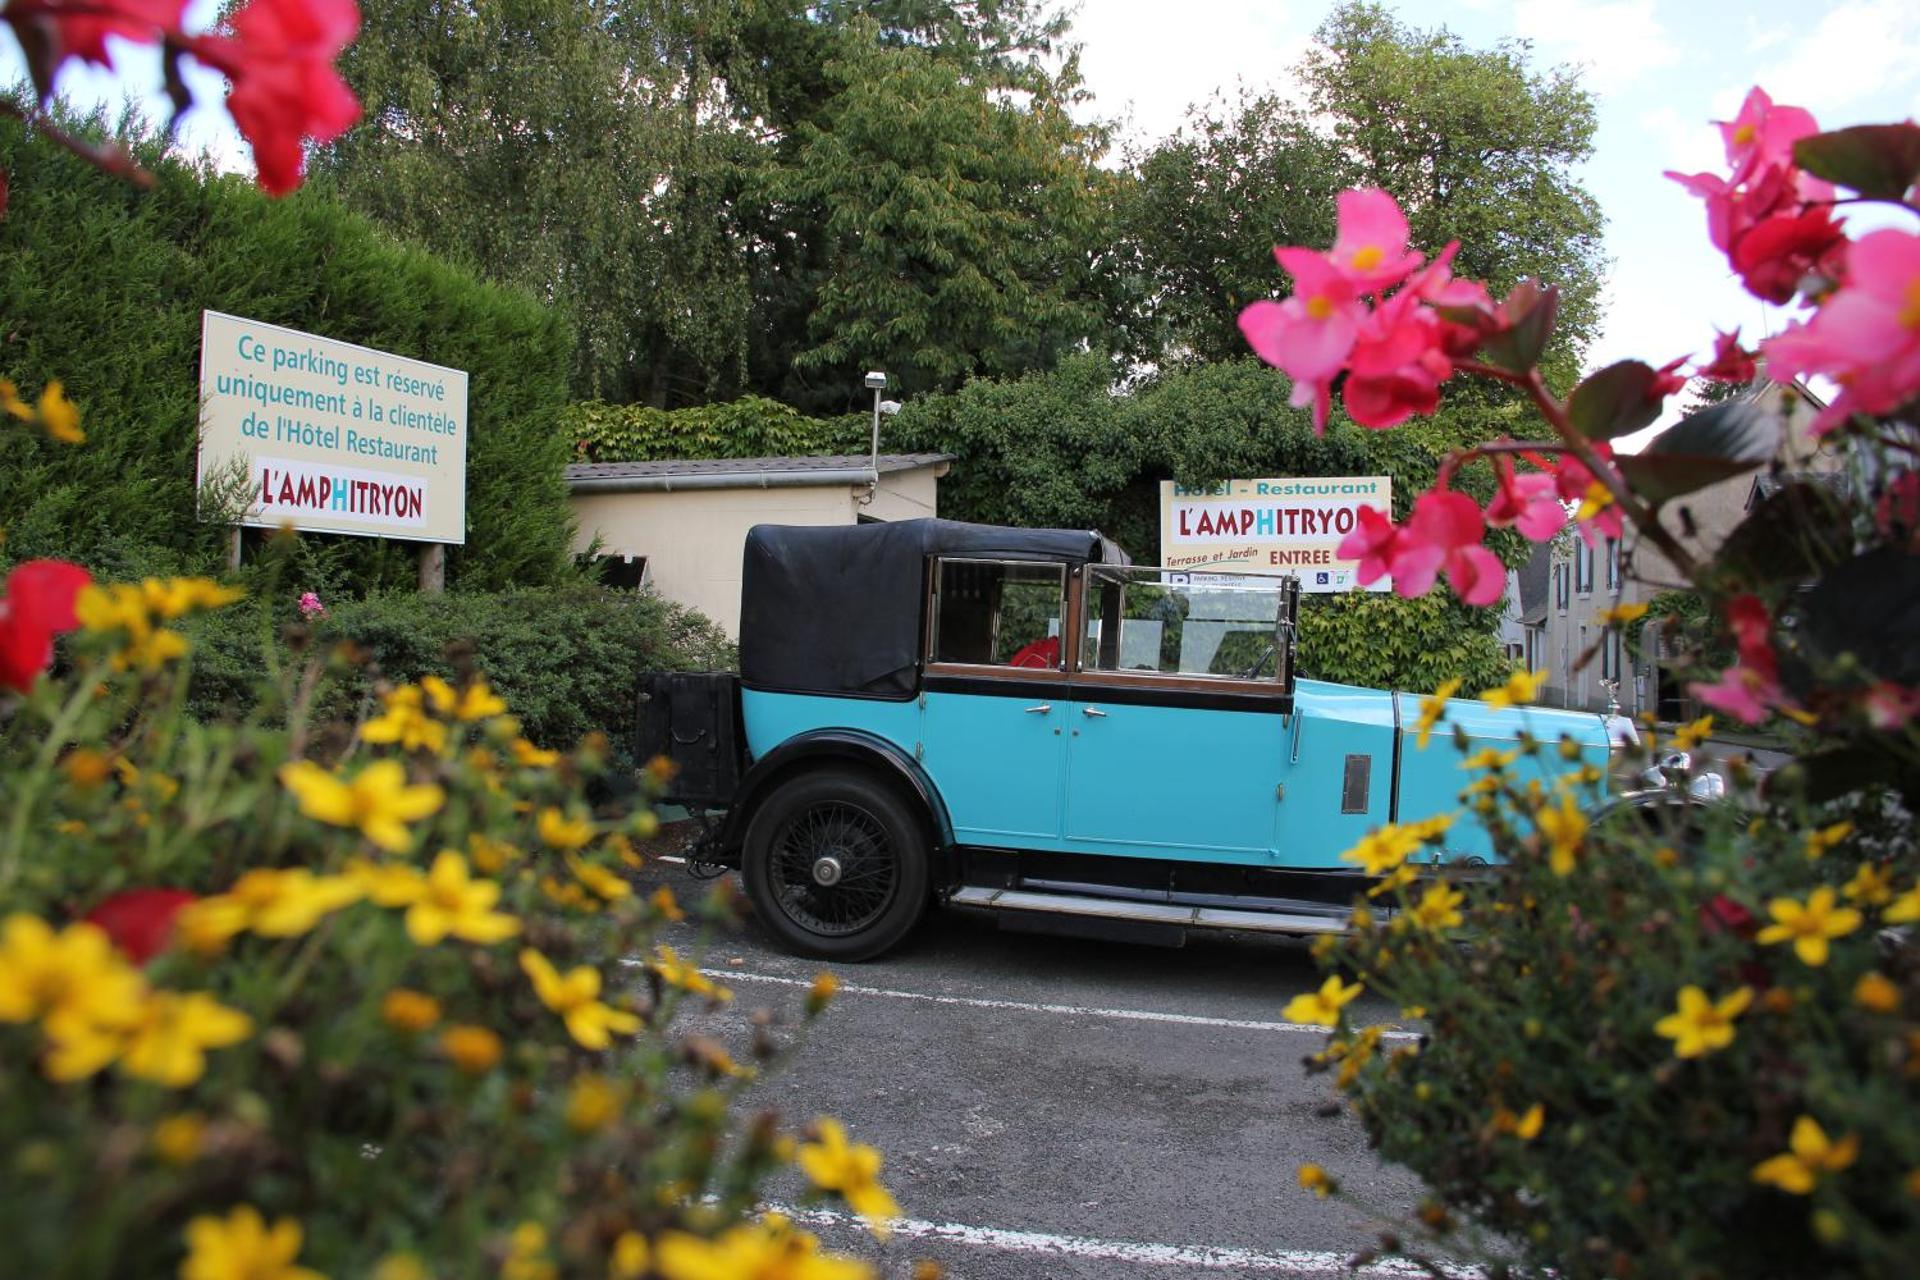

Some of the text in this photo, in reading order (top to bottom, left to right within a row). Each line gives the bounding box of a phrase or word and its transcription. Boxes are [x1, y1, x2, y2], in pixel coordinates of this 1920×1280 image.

[238, 334, 445, 401] Ce parking est réservé
[216, 374, 457, 436] uniquement à la clientèle
[241, 412, 438, 465] de l'Hôtel Restaurant
[262, 468, 422, 519] L'AMPHITRYON
[1256, 482, 1377, 496] Restaurant
[1179, 508, 1359, 536] L'AMPHITRYO
[1167, 555, 1208, 567] Terrasse
[1213, 552, 1223, 561] et
[1228, 547, 1258, 560] Jardin
